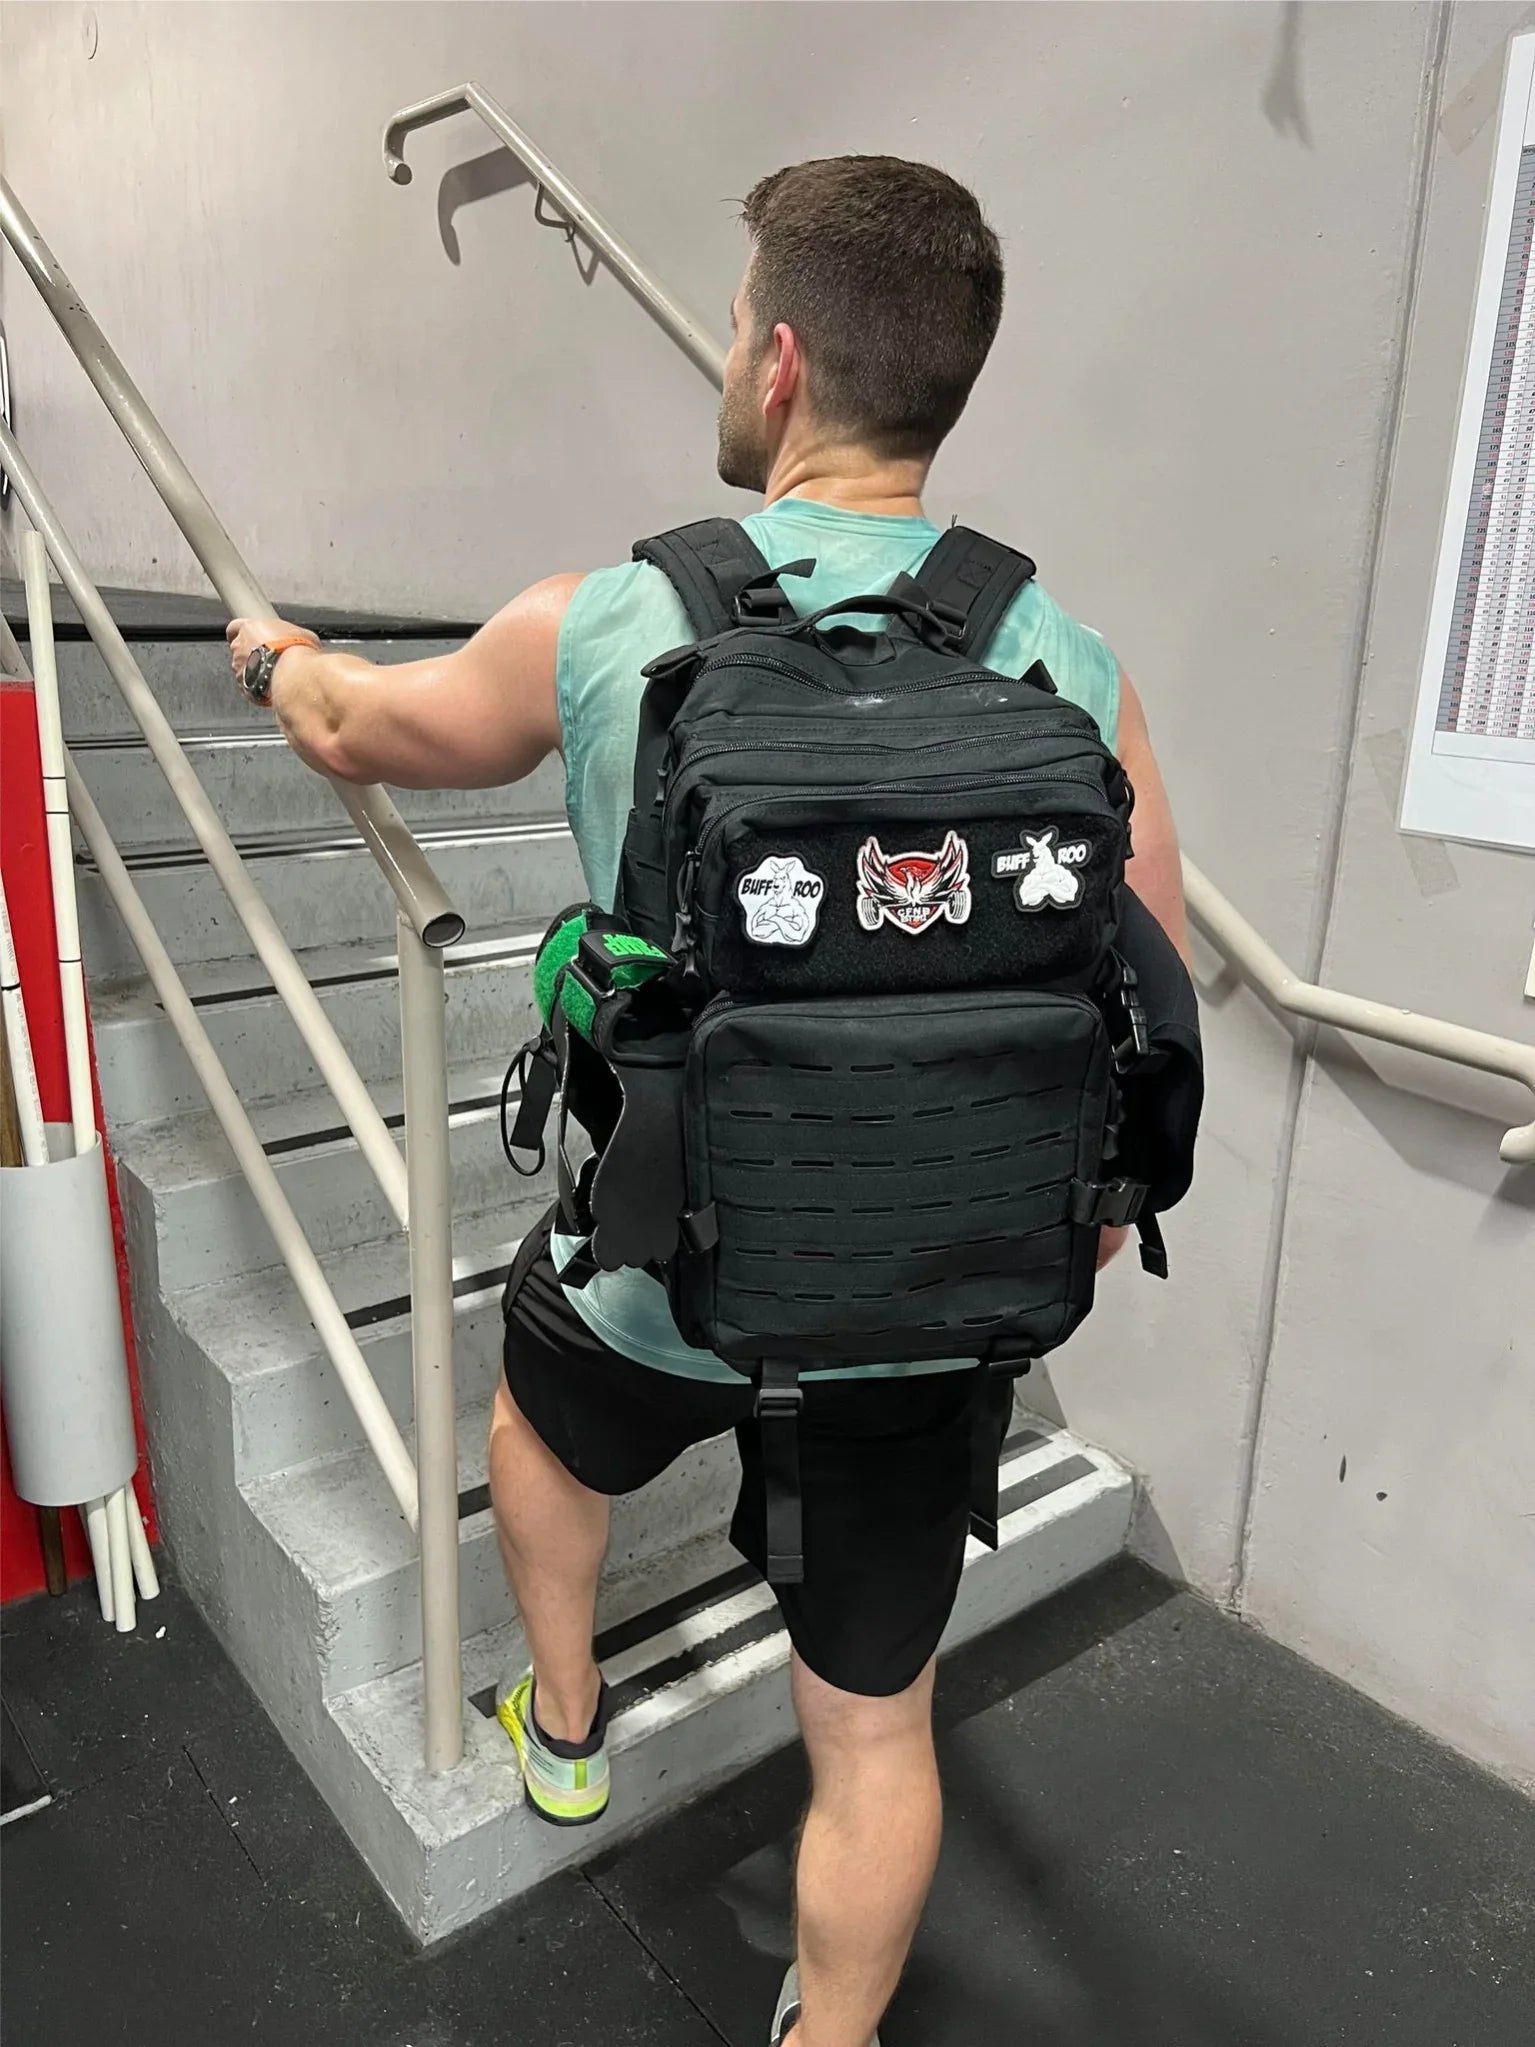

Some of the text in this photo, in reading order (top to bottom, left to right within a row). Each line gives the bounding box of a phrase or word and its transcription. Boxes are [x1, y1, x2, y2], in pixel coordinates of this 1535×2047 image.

[996, 844, 1087, 873] BUFF ROO
[740, 878, 822, 898] BUFF ROO
